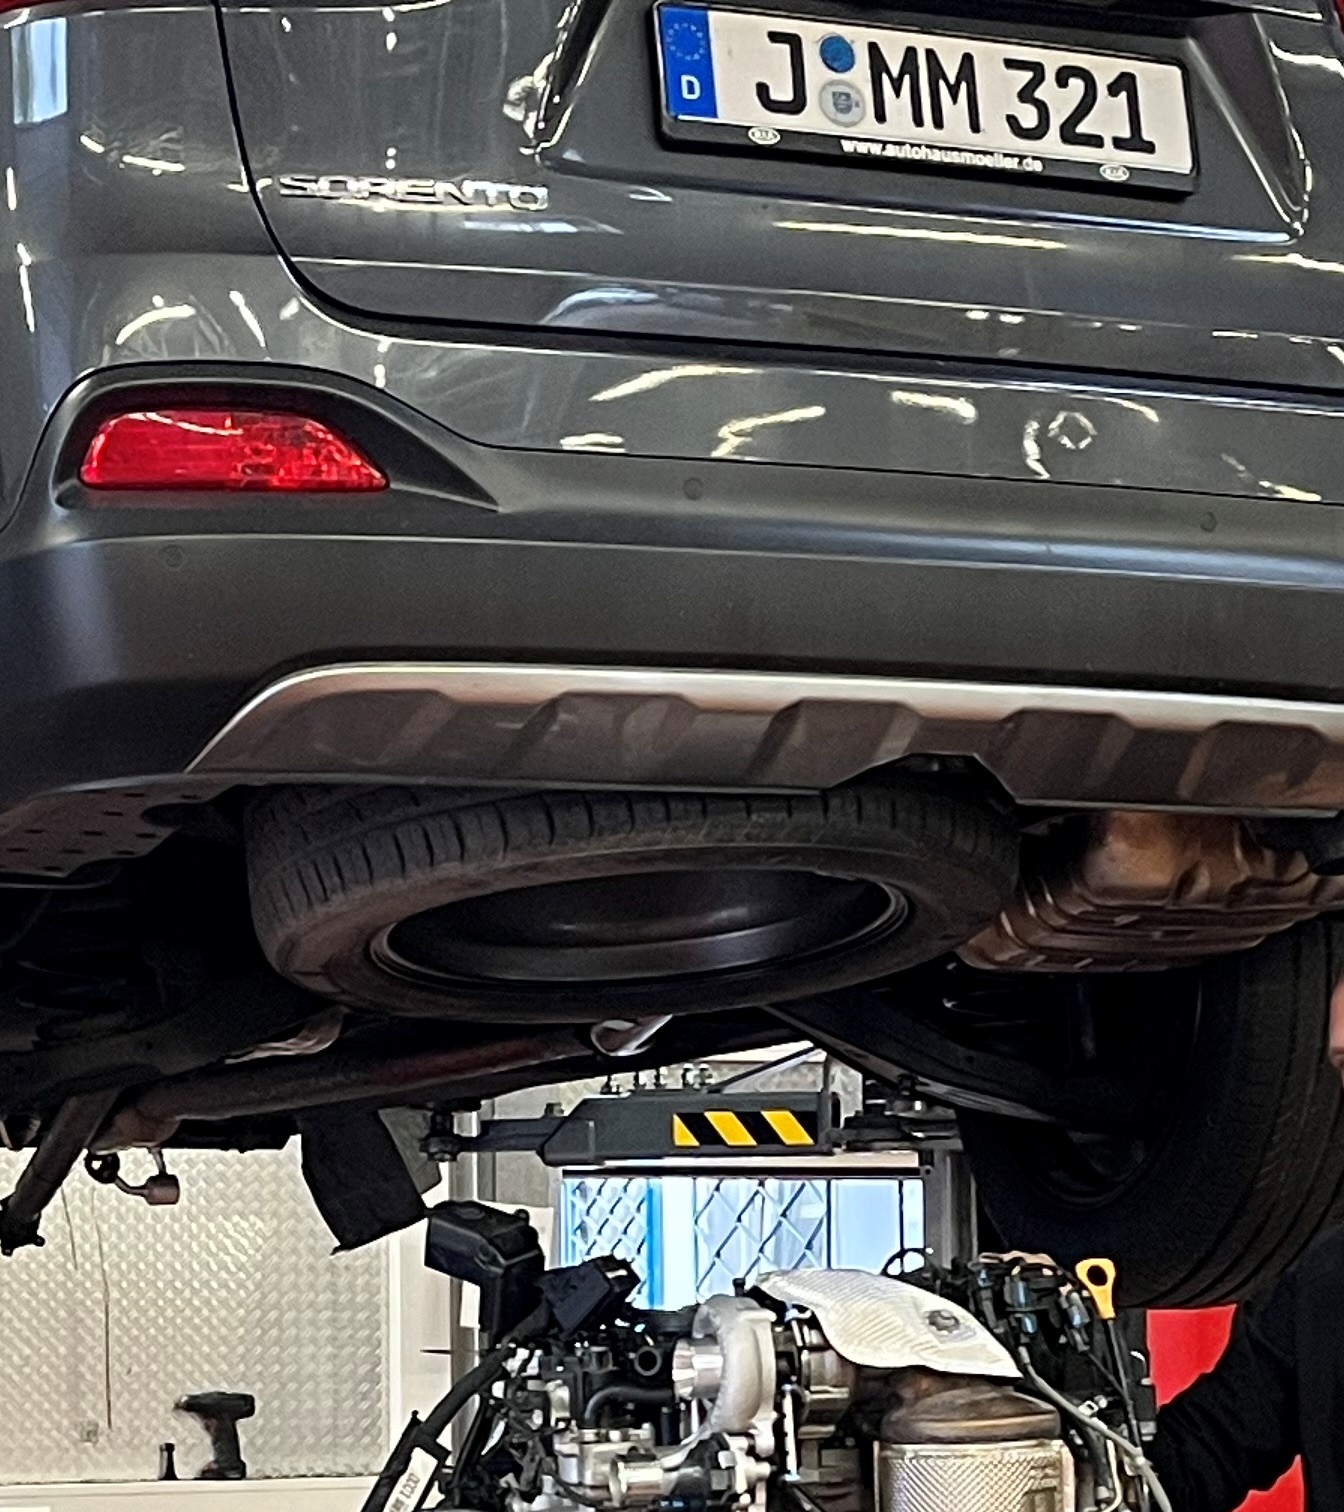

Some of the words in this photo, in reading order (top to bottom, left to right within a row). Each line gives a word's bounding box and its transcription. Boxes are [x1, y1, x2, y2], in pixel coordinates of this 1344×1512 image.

[680, 74, 701, 100] D
[755, 30, 807, 115] J
[868, 41, 982, 134] MM
[1002, 57, 1156, 155] 321
[279, 174, 549, 212] SORENTO
